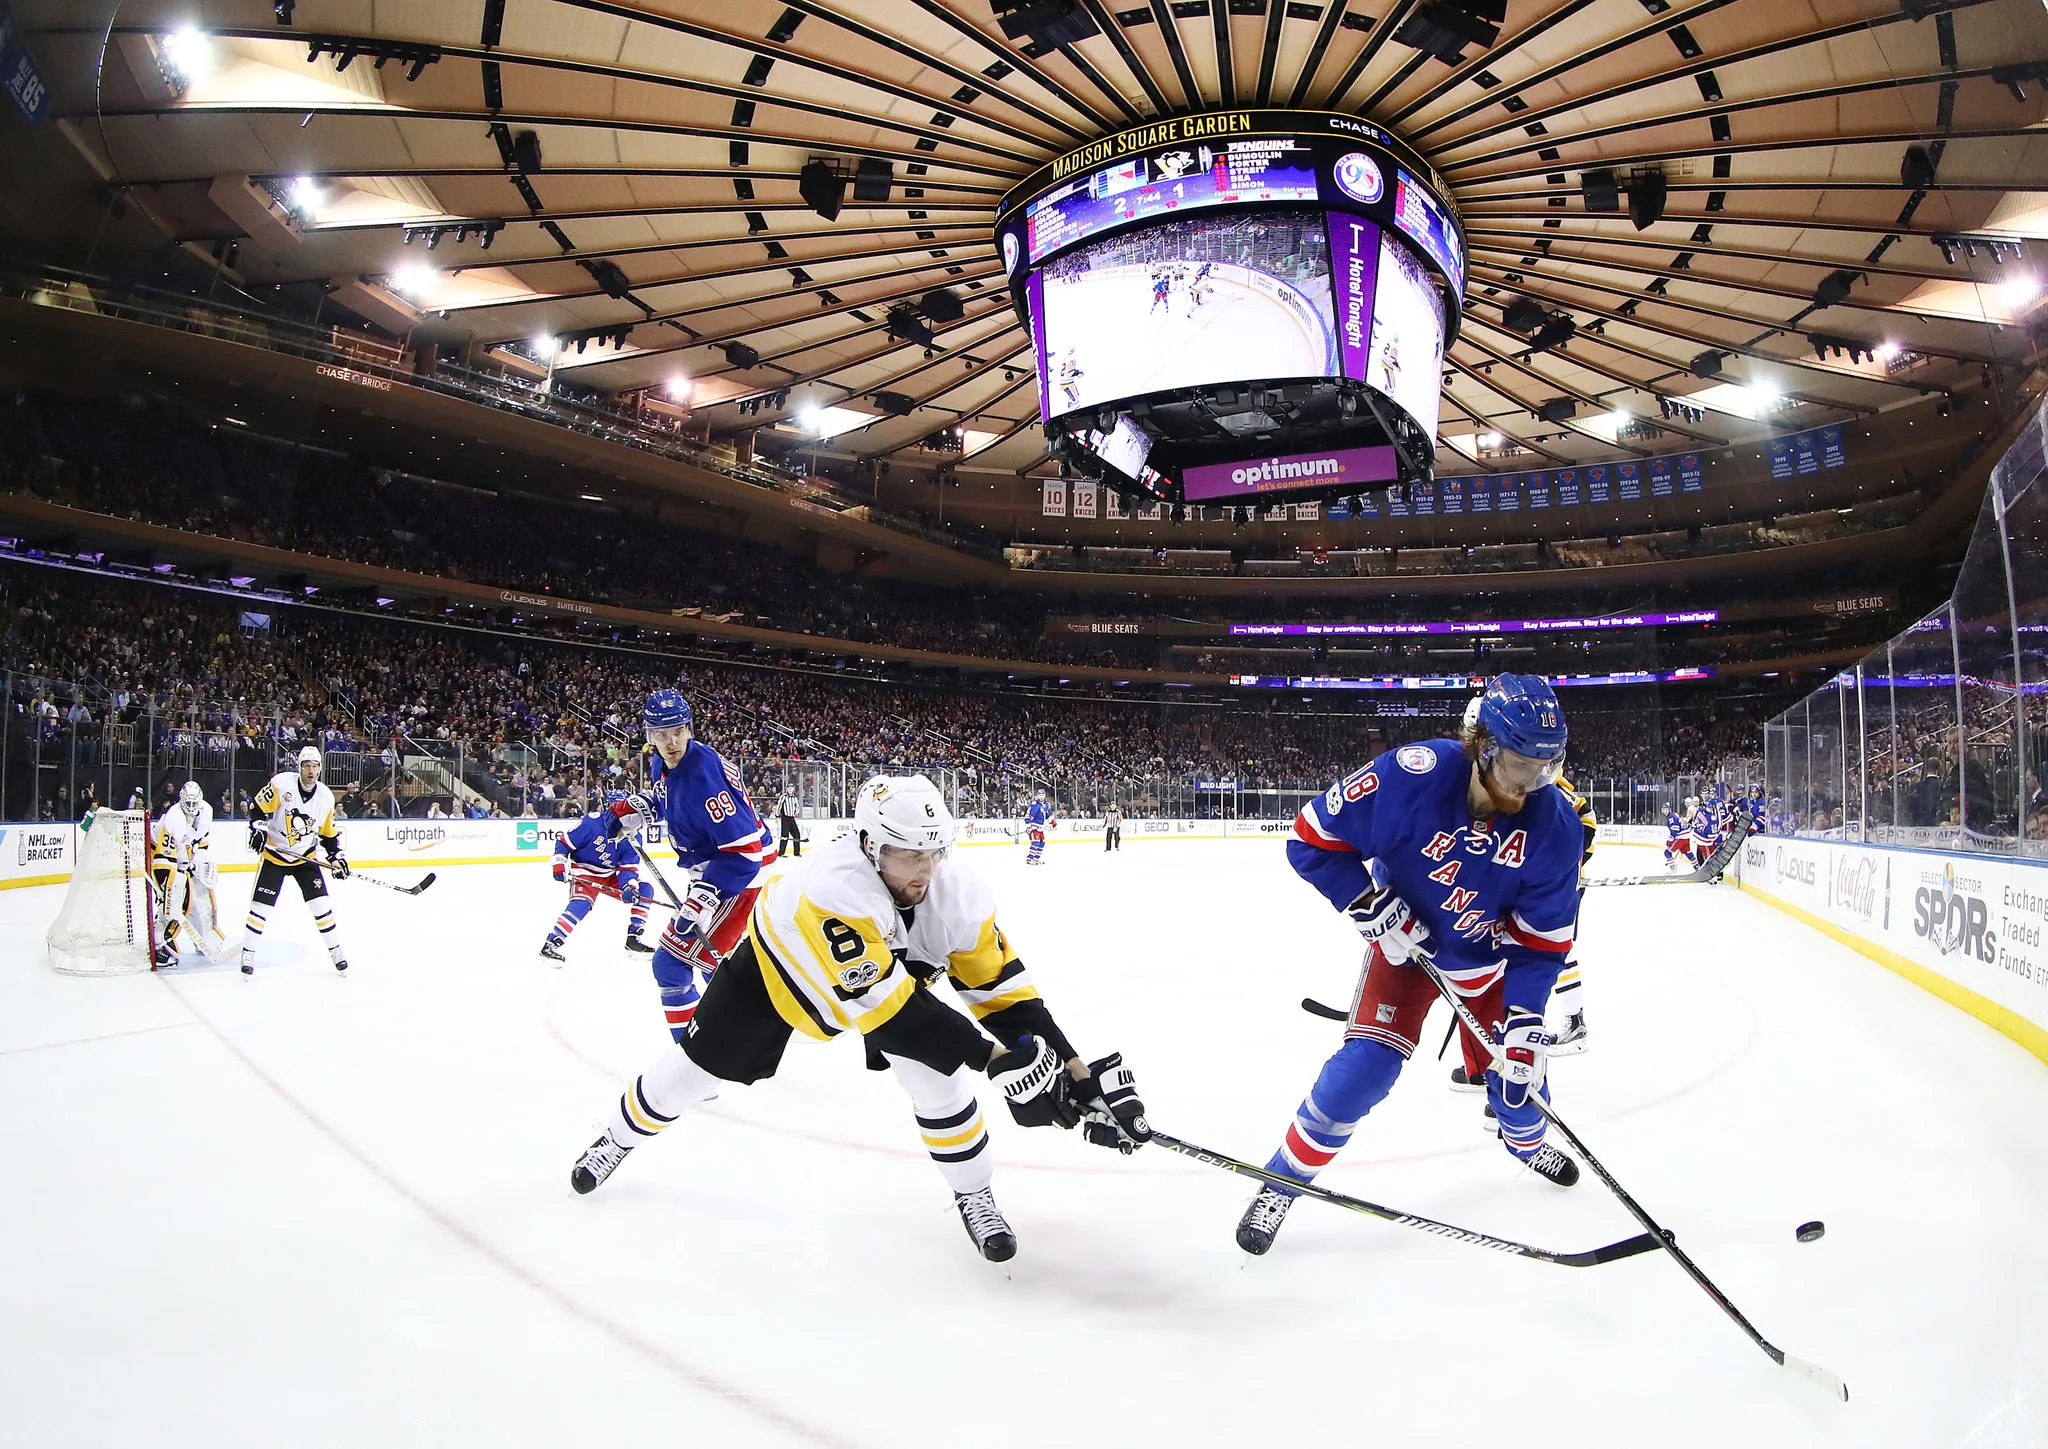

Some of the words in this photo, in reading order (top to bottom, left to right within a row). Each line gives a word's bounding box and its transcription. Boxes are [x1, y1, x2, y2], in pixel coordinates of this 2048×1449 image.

[22, 74, 45, 113] 85
[1329, 118, 1379, 139] CHASE
[1052, 140, 1112, 181] MADISON
[1117, 122, 1178, 153] SQUARE
[1183, 114, 1251, 137] GARDEN
[1227, 139, 1295, 153] PENGUINS
[1228, 152, 1282, 162] DUMOULIN
[1229, 160, 1270, 169] PORTER
[1230, 167, 1266, 175] STREIT
[1230, 174, 1251, 182] DEA
[1172, 182, 1184, 198] 1
[1231, 181, 1265, 190] SIMON
[1114, 197, 1127, 214] 2
[1345, 257, 1364, 348] HotelTonight
[316, 365, 350, 382] CHASE
[361, 377, 392, 391] BRIDGE
[1257, 481, 1275, 491] let's
[1277, 478, 1314, 489] connect
[1316, 476, 1340, 486] more
[790, 499, 812, 511] CHASE
[1047, 491, 1062, 505] 10
[1078, 493, 1093, 507] 12
[1044, 506, 1065, 514] KNICKS
[1075, 508, 1095, 516] KNICKS
[1297, 510, 1318, 518] KNICKS
[513, 596, 547, 606] LEXUS
[556, 601, 574, 611] SUITE
[575, 603, 593, 614] LEVEL
[1837, 600, 1858, 612] BLUE
[1859, 596, 1883, 609] SEATS
[1523, 621, 1538, 629] Stay
[1583, 619, 1599, 627] Stay
[1623, 617, 1643, 626] night.
[1679, 612, 1715, 622] HotelTonight
[1092, 624, 1113, 633] BLUE
[1114, 624, 1139, 634] SEATS
[1247, 626, 1284, 635] HotelTonight
[1367, 625, 1383, 633] Stay
[1408, 625, 1427, 633] night.
[1464, 622, 1500, 632] HotelTonight
[1541, 711, 1557, 728] 18
[1200, 782, 1214, 790] BUD
[1215, 782, 1236, 790] LIGHT
[1342, 760, 1380, 803] 18
[1637, 784, 1648, 792] BUD
[705, 790, 736, 823] 89
[1144, 822, 1169, 832] GEICO
[1261, 823, 1293, 833] optim
[162, 834, 176, 849] 35
[387, 827, 446, 845] Lightpath
[27, 848, 63, 861] BRACKET
[1491, 829, 1528, 868] A
[1785, 857, 1815, 886] LEXUS
[1588, 876, 1645, 886] CCM
[1921, 871, 1942, 886] SELECT
[1955, 876, 1982, 893] SECTOR
[2004, 885, 2048, 921] Exchang
[1361, 901, 1408, 938] AUER
[2002, 916, 2040, 948] Traded
[666, 930, 689, 949] UER
[1999, 947, 2032, 980] Funds
[1457, 1003, 1495, 1045] EASTON
[1004, 1048, 1055, 1097] WARRI
